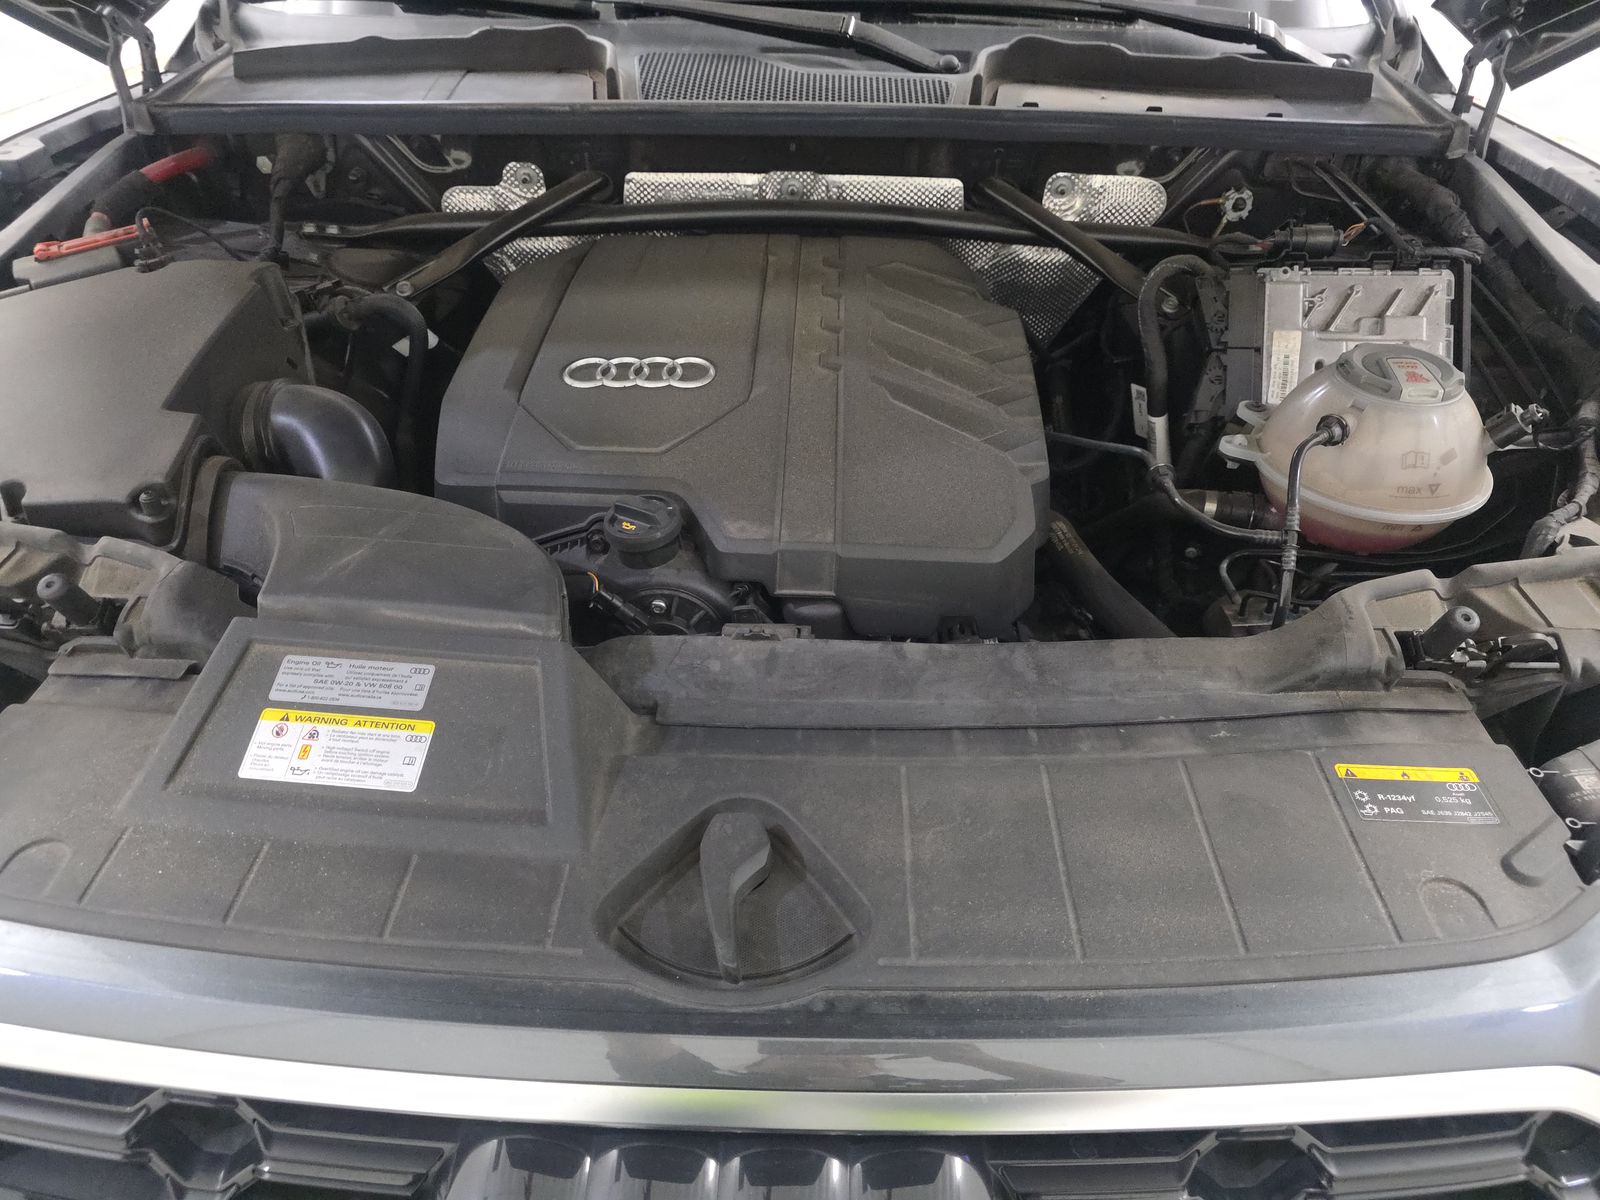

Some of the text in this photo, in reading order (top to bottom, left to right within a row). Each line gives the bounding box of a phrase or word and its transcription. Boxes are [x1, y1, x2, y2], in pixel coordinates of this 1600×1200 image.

[1396, 485, 1422, 495] max
[295, 715, 416, 731] WARNING ATTENTION
[1377, 794, 1415, 802] R-1234yf
[1460, 797, 1471, 805] kg
